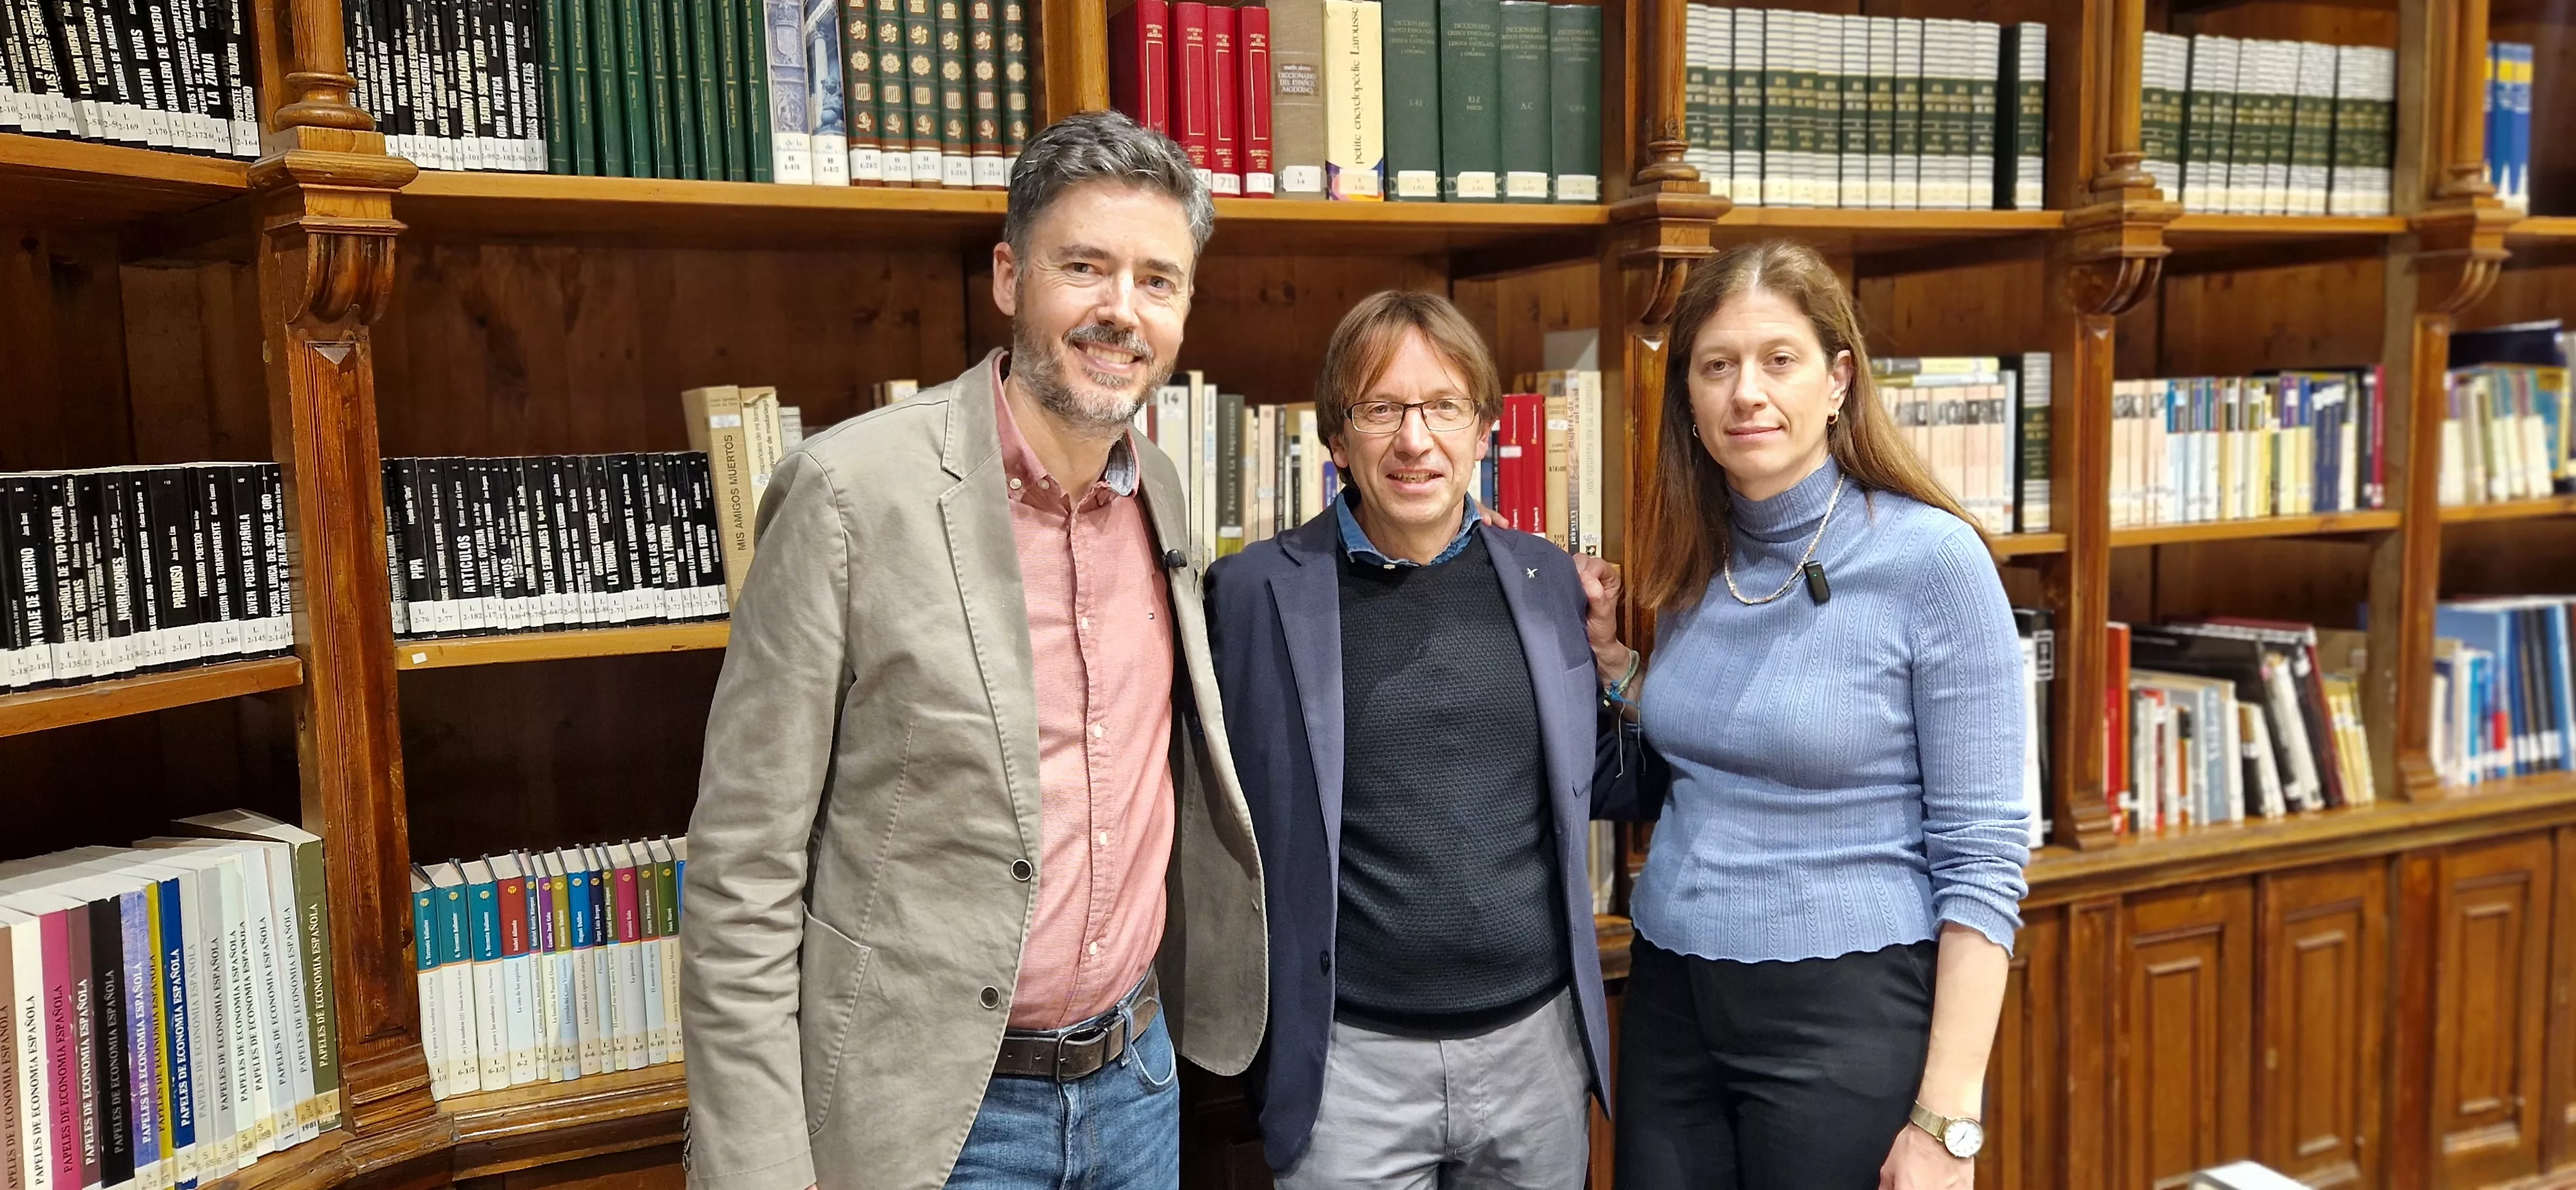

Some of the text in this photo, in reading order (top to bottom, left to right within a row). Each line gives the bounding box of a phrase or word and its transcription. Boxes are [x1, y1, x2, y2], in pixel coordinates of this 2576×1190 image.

[35, 38, 59, 91] LAS ARMAS
[83, 6, 109, 85] EL RUFIAN DICHOSO
[130, 29, 159, 109] MARTIN RIVAS
[149, 5, 180, 111] CABALLERO DE OLMEDO
[227, 42, 241, 87] DE TALAVERA
[394, 54, 405, 77] POESIA
[433, 55, 444, 74] ALBA
[202, 53, 220, 105] LA ZANJA
[242, 86, 255, 122] CORBACHO
[397, 84, 408, 106] PROSA
[420, 53, 435, 120] CAMPOS DE CASTILLA
[473, 39, 491, 124] TEATRO SOBRE TEATRO
[522, 62, 538, 118] INCOMPLETAS
[1291, 78, 1316, 86] ESPAÑOL
[1350, 7, 1364, 165] petite encyclopédie Larousse
[438, 107, 449, 117] DE
[439, 118, 450, 136] CASA
[491, 76, 507, 137] OBRA POETICA
[762, 399, 772, 434] madariaga
[1164, 392, 1179, 404] 14
[1568, 401, 1574, 411] de
[724, 435, 746, 551] MIS AMIGOS MUERTOS
[52, 505, 73, 619] ESPAÑOLA DE TIPO POPULAR
[239, 514, 258, 615] JOVEN POESIA ESPAÑOLA
[457, 534, 477, 593] ARTICULOS
[475, 529, 491, 586] FUENTE OVEJUNA
[587, 512, 604, 576] CANTARES GALLEGOS
[603, 540, 619, 585] LA TRIBUNA
[660, 524, 675, 553] FIGURA
[696, 524, 712, 574] MARTIN FIERRO
[112, 556, 129, 621] NARRACIONES
[169, 565, 186, 609] PARADISO
[193, 533, 208, 598] ITINERARIO POETICO
[211, 521, 230, 621] REGION MAS TRANSPARENTE
[409, 558, 425, 580] PIPA
[501, 558, 516, 588] PASOS
[665, 561, 679, 583] GENIO
[21, 547, 43, 638] VIAJE DE INVIERNO
[73, 578, 86, 612] OBRAS
[172, 643, 191, 652] 2-147
[220, 636, 238, 645] 2-186
[247, 634, 266, 643] 2-145
[30, 662, 50, 671] 2-181
[60, 660, 80, 670] 2-135
[133, 962, 151, 1144] PAPELES DE ECONOMIA ESPAÑOLA
[170, 948, 191, 1127] PAPELES DE ECONOMIA ESPAÑOLA
[187, 944, 207, 1119] PAPELES DE ECONOMIA ESPAÑOLA
[53, 985, 73, 1173] PAPELES DE ECONOMIA ESPAÑOLA
[77, 978, 95, 1166] PAPELES DE ECONOMIA ESPAÑOLA
[104, 969, 124, 1155] PAPELES DE ECONOMIA ESPAÑOLA
[431, 1075, 447, 1083] 6-1/1
[24, 996, 44, 1186] PAPELES DE ECONOMIA ESPAÑOLA
